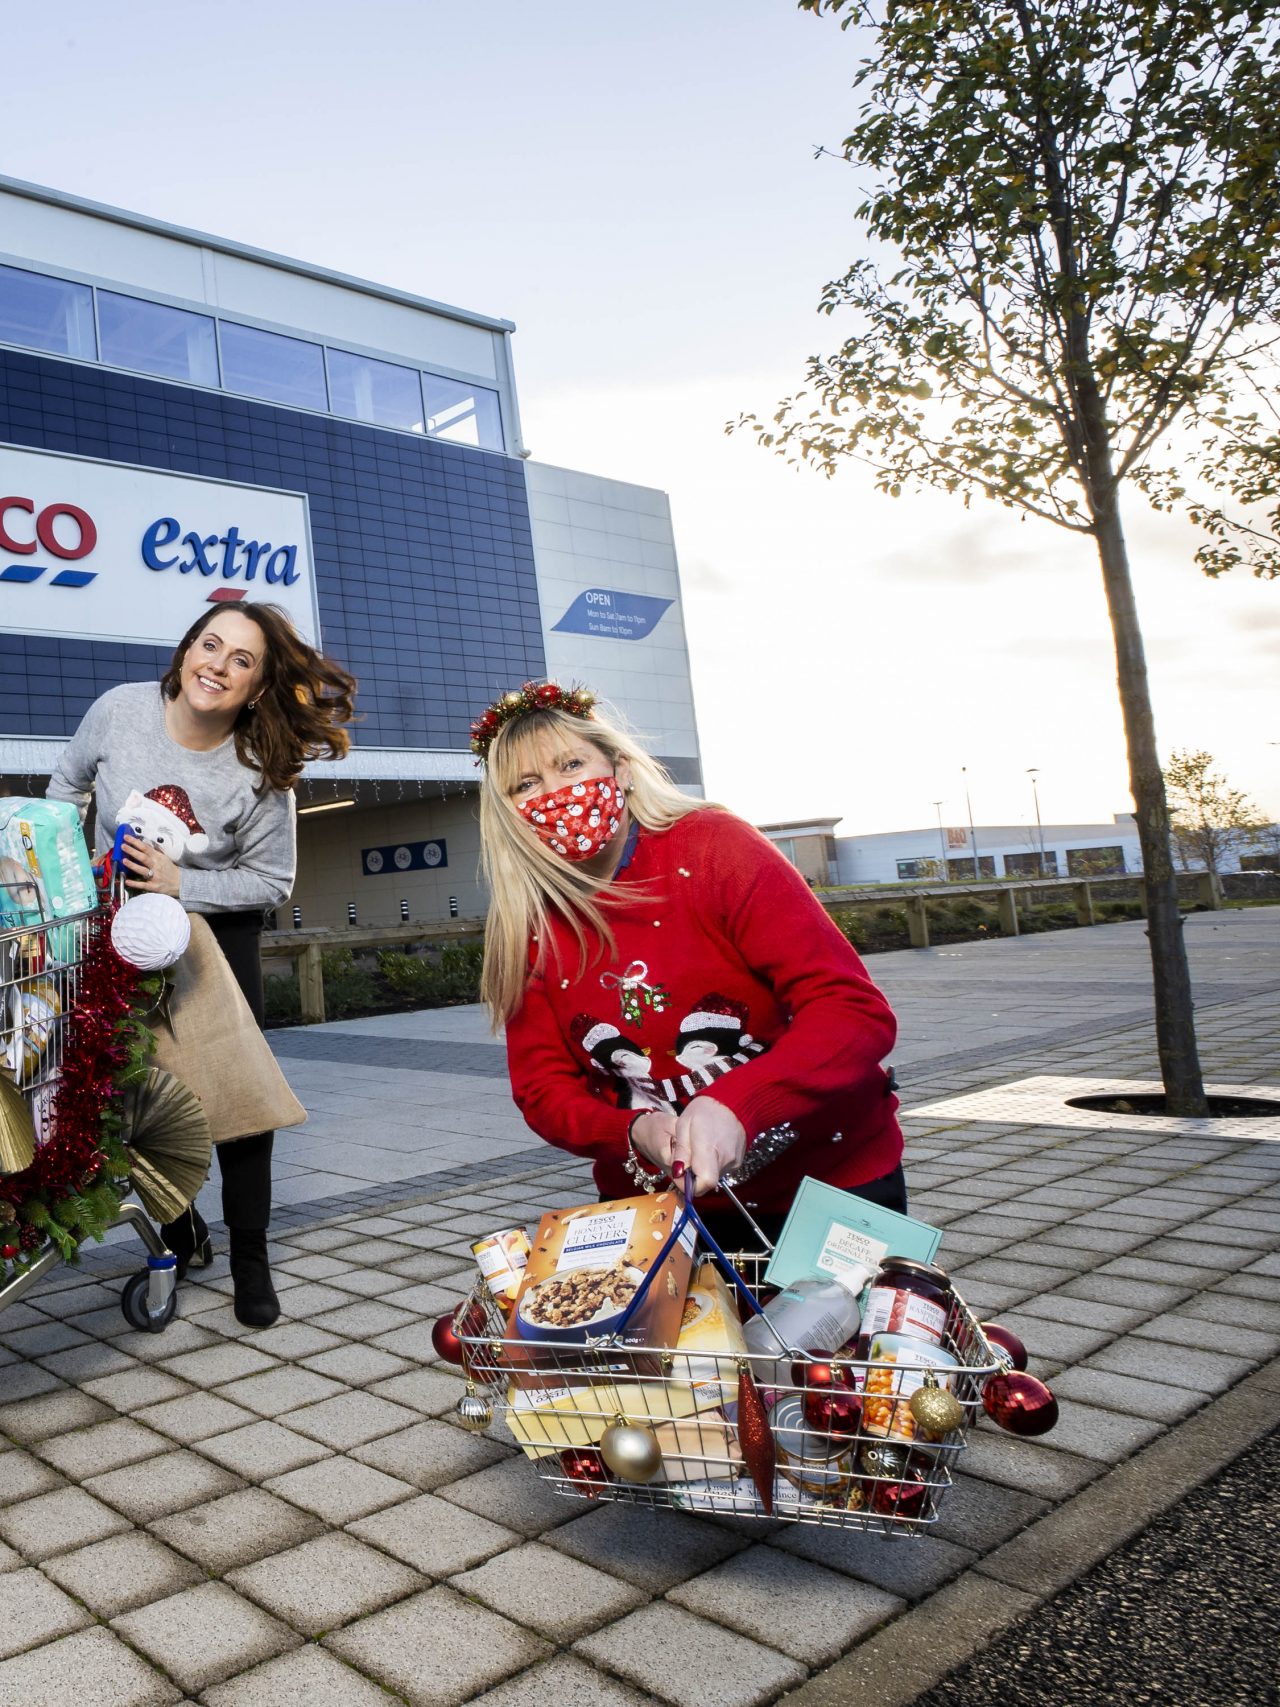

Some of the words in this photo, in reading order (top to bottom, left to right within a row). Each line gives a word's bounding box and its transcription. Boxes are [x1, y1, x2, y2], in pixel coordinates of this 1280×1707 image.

[141, 516, 301, 586] extra
[585, 591, 611, 606] OPEN
[587, 609, 599, 617] Mon
[600, 610, 606, 618] to
[588, 622, 599, 631] Sun
[612, 625, 618, 633] to
[618, 626, 633, 635] 10pm
[588, 1215, 616, 1225] TESCO
[574, 1225, 602, 1236] HONEY
[606, 1221, 625, 1230] NUT
[566, 1229, 629, 1246] CLUSTERS
[847, 1232, 871, 1245] TESCO
[827, 1240, 861, 1259] ORIGINAL
[914, 1354, 937, 1366] TESCO
[535, 1388, 568, 1403] TESCO
